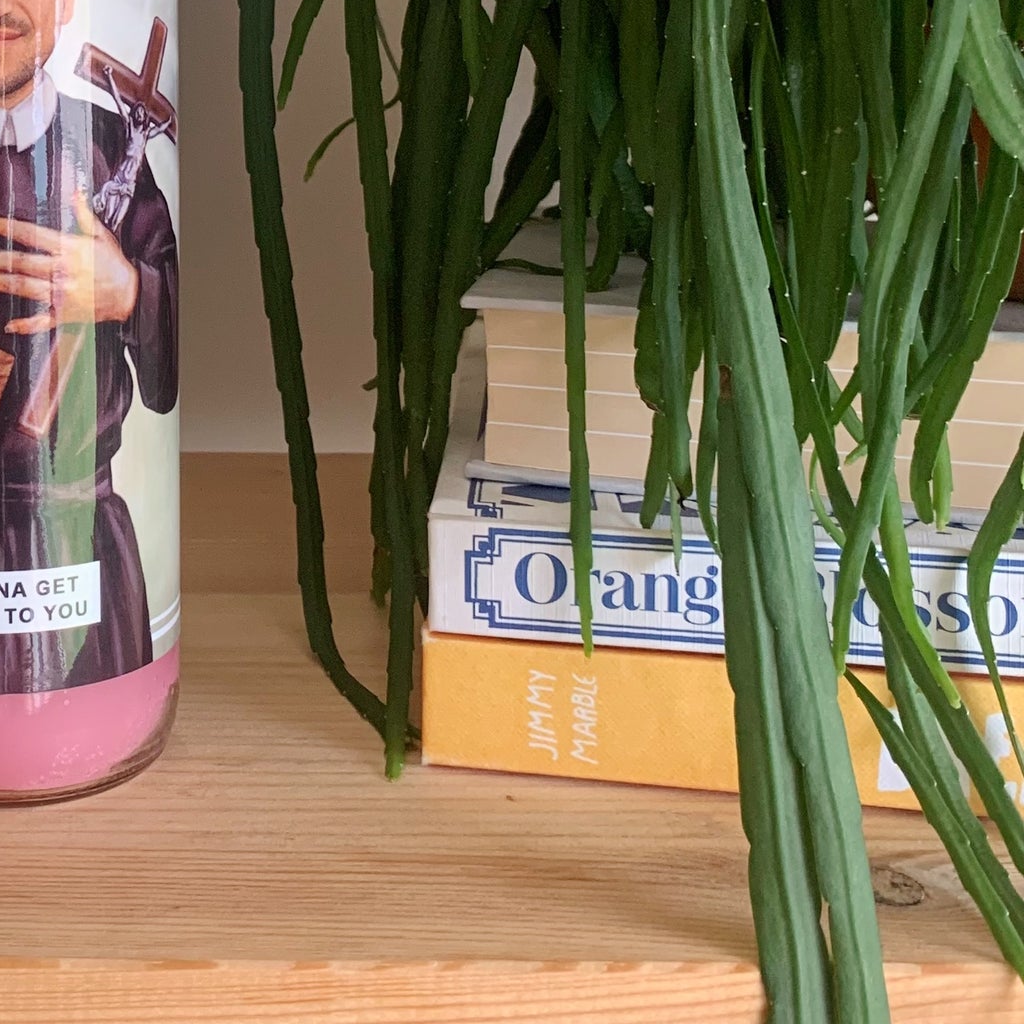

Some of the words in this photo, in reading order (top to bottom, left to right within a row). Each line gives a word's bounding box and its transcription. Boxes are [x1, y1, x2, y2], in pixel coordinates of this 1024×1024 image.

[4, 607, 35, 624] TO
[43, 600, 88, 621] YOU
[35, 576, 79, 596] GET
[514, 551, 721, 626] Oang
[526, 669, 558, 760] JIMMY
[570, 672, 599, 765] MARBLE
